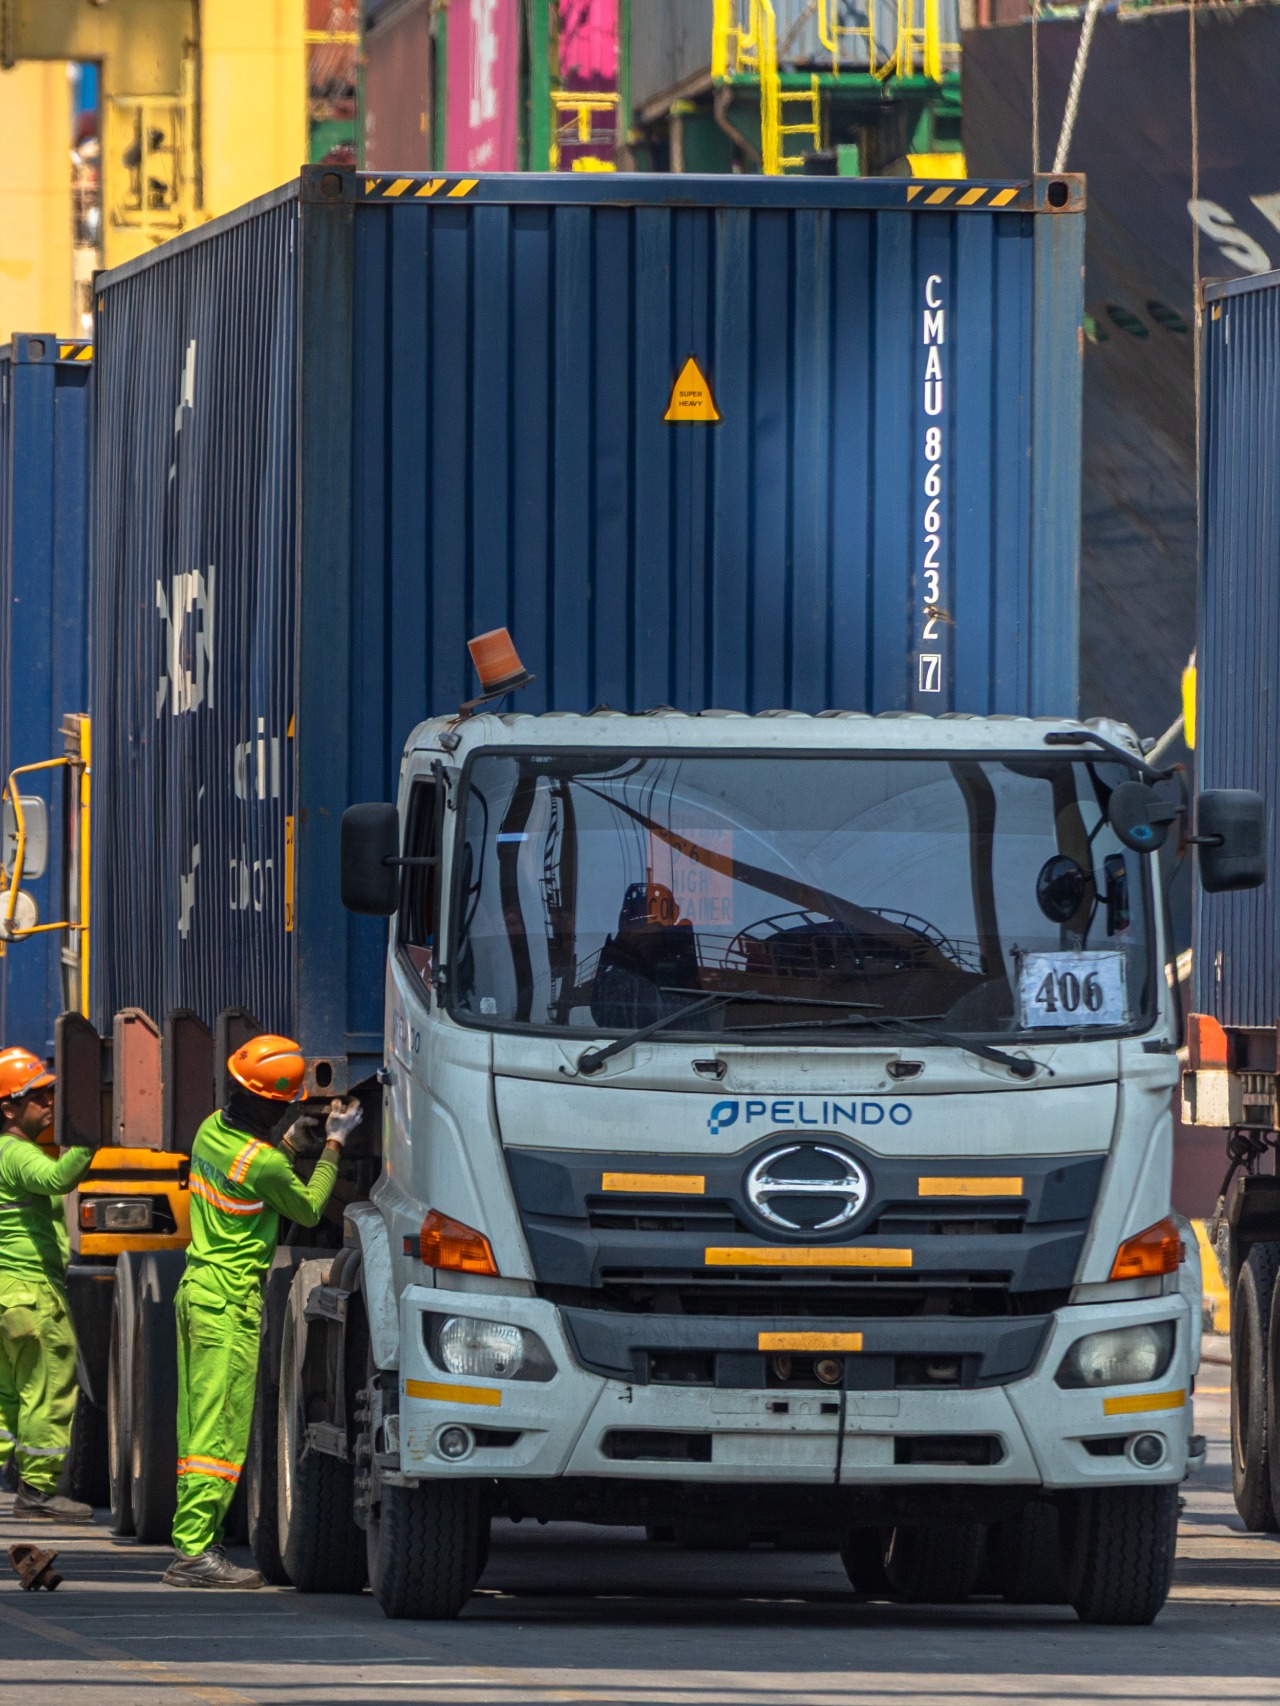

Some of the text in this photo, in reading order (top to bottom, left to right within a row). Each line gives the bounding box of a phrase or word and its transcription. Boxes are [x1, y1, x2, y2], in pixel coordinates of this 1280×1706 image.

[921, 275, 945, 691] CMAU 866232 7
[1035, 969, 1103, 1012] 406
[746, 1100, 912, 1126] PELINDO
